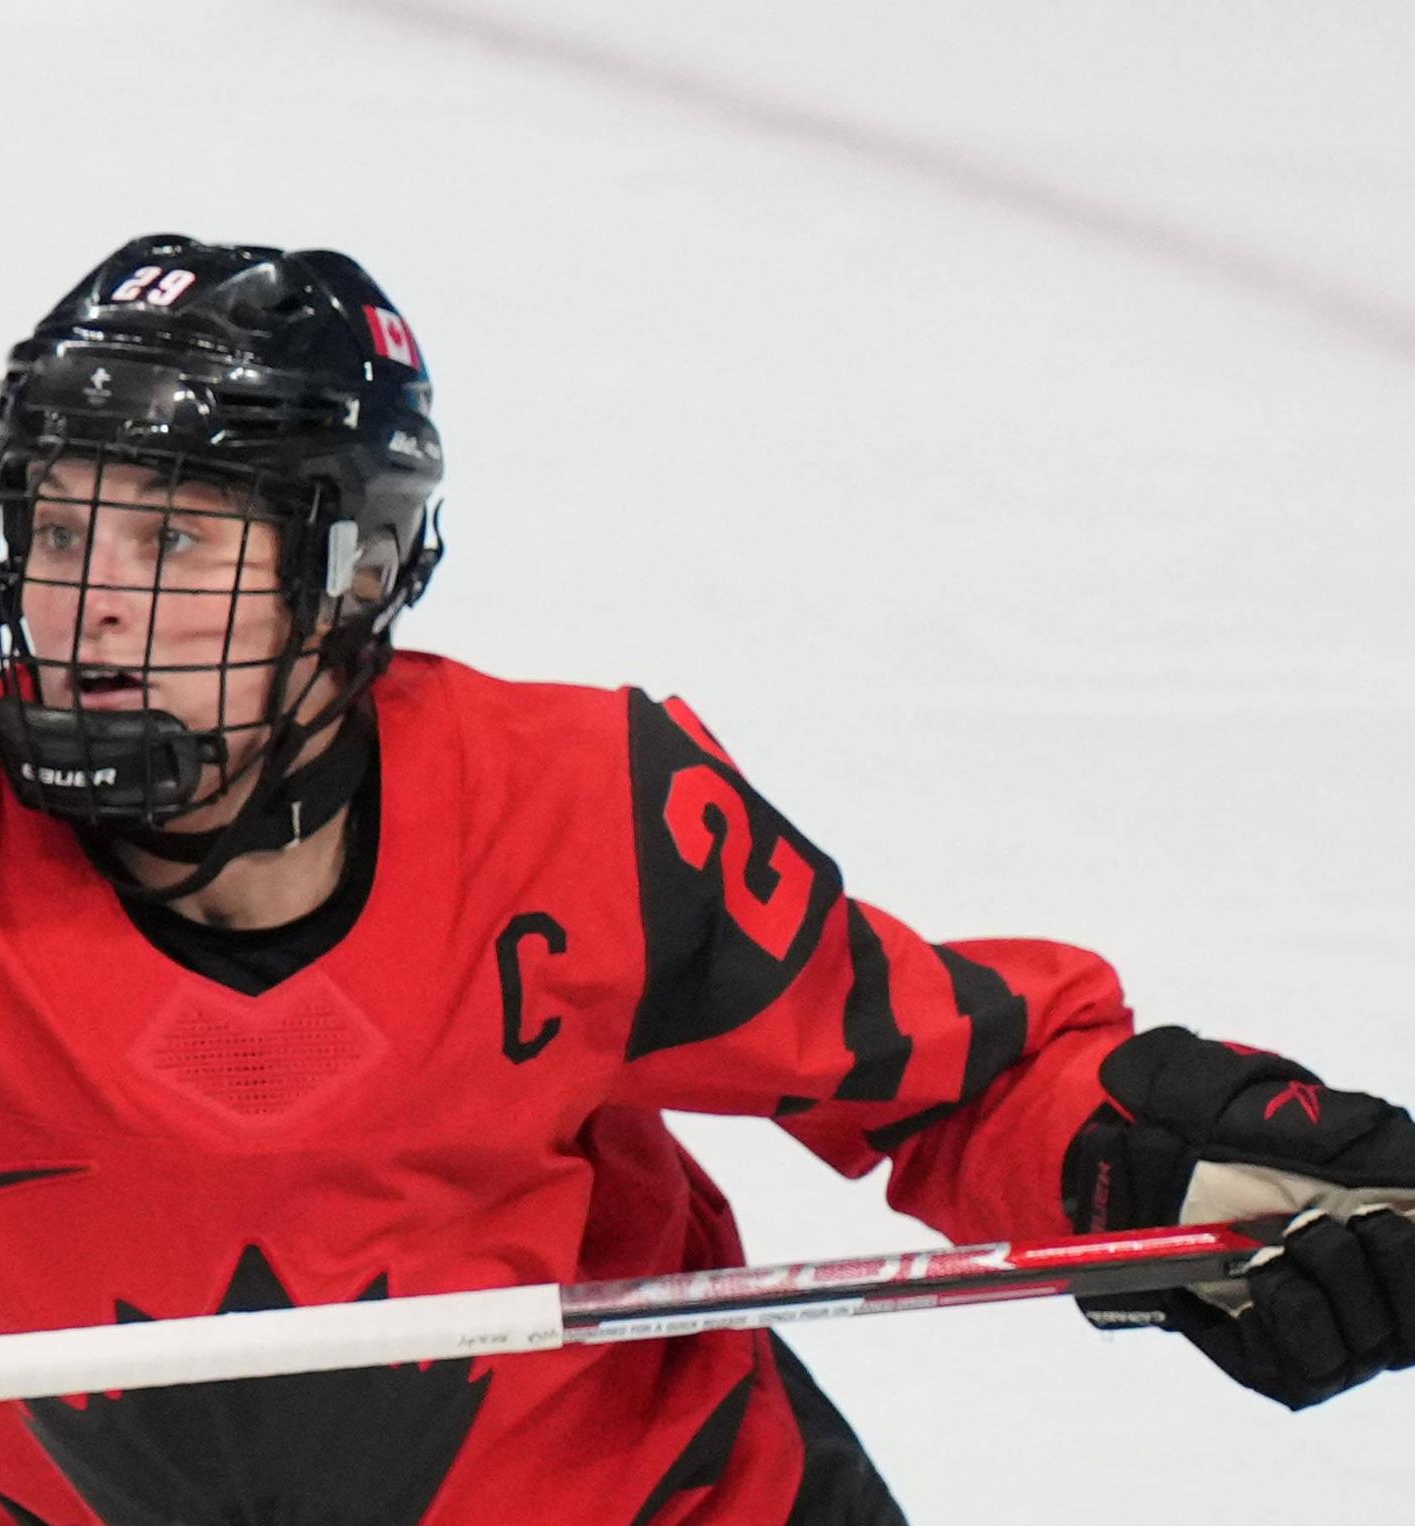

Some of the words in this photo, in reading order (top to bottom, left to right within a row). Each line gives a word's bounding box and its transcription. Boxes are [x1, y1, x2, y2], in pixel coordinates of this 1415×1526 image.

[112, 265, 197, 307] 29
[663, 694, 816, 962] 2
[495, 911, 567, 1065] C
